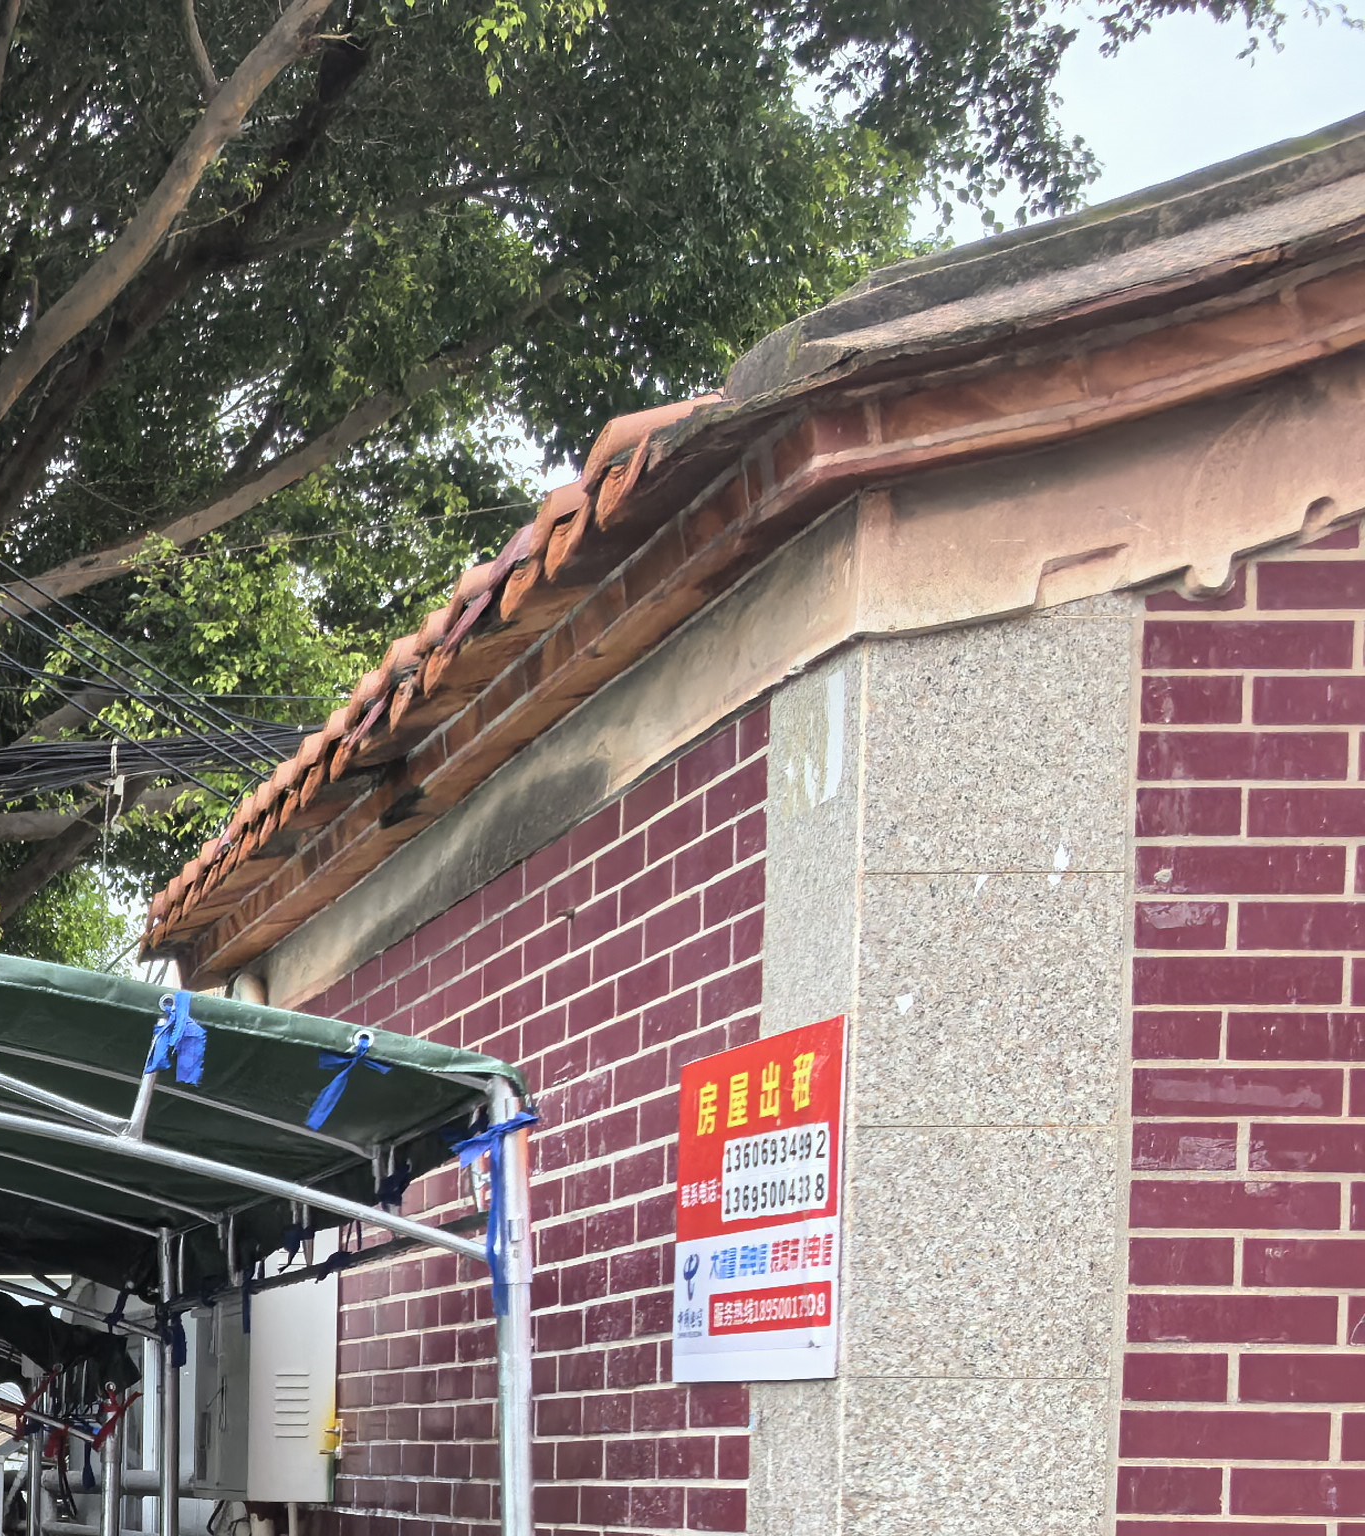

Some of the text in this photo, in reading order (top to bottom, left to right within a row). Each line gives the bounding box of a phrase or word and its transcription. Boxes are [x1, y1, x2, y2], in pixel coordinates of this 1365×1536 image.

[696, 1052, 816, 1137] 房屋出租
[725, 1129, 827, 1173] 13606934992
[724, 1173, 825, 1215] 13695004338
